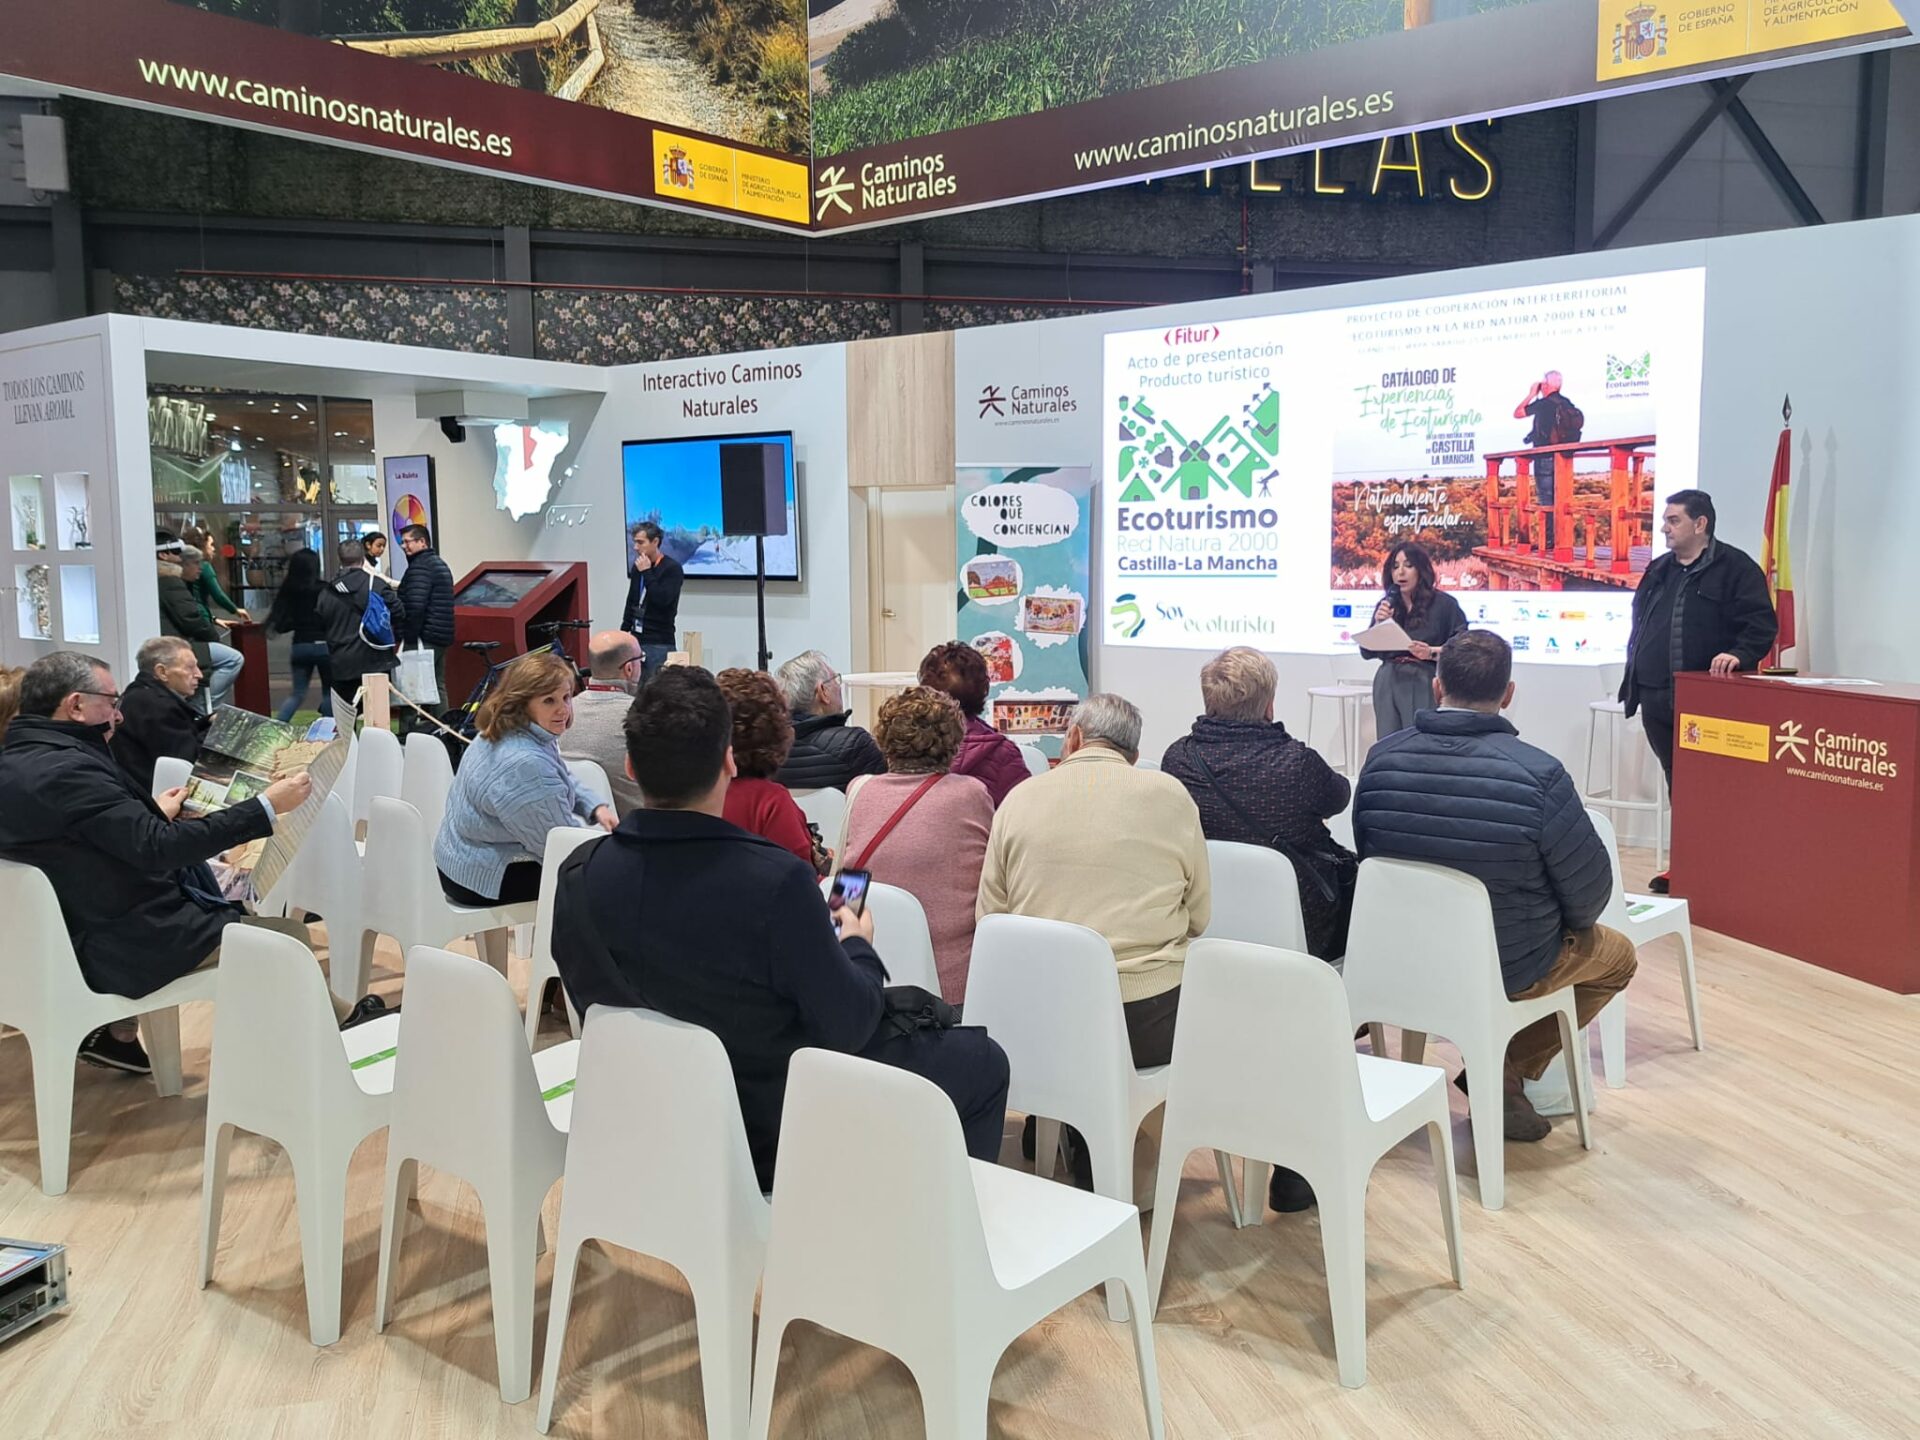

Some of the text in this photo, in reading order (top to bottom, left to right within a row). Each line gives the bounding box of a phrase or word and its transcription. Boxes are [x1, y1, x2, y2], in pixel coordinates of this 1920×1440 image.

[1678, 3, 1735, 22] GOBIERNO
[1678, 14, 1735, 33] DE ESPAÑA
[1763, 6, 1779, 16] DE
[1763, 1, 1859, 28] Y ALIMENTACIÓN
[138, 57, 512, 158] www.caminosnaturales.es
[1074, 89, 1395, 171] www.caminosnaturales.es
[698, 163, 728, 176] GOBIERNO
[708, 172, 728, 183] ESPAÑA
[860, 153, 945, 187] Caminos
[861, 172, 957, 210] Naturales
[1346, 285, 1628, 324] PROYECTO DE COOPERACIÓN INTERTERRITORIAL
[1352, 325, 1422, 342] ECOTURISMO
[1426, 324, 1440, 335] EN
[1445, 321, 1459, 333] LA
[1463, 319, 1485, 331] RED
[1489, 314, 1539, 328] NATURA
[1543, 310, 1575, 323] 2000
[1579, 308, 1595, 319] EN
[1600, 304, 1627, 317] CLM
[1127, 341, 1284, 370] Acto de presentación
[2, 369, 85, 401] TODOS LOS CAMINOS
[642, 360, 803, 393] Interactivo Caminos
[1139, 372, 1202, 388] Producto
[1381, 367, 1457, 388] CATÁLOGO DE
[1011, 384, 1069, 400] Caminos
[1353, 384, 1455, 418] Experiencias
[14, 402, 43, 425] LLEVAN
[682, 395, 758, 418] Naturales
[1011, 397, 1078, 415] Naturales
[1379, 405, 1483, 438] de Ecoturismo
[1431, 439, 1475, 453] CASTILLA
[1431, 453, 1475, 465] LA MANCHA
[970, 495, 1023, 508] COLORES
[1354, 482, 1448, 513] Naturalmente
[1000, 507, 1023, 520] QUE
[1117, 503, 1279, 532] Ecoturismo
[1383, 506, 1474, 535] espectacular...
[993, 523, 1071, 535] CONCIENCIAN
[1117, 531, 1279, 552] Red Natura 2000
[1117, 555, 1278, 571] Castilla-La Mancha
[1814, 728, 1888, 757] Caminos
[1814, 748, 1898, 778] Naturales
[1786, 765, 1885, 792] www.caminosnaturales.es
